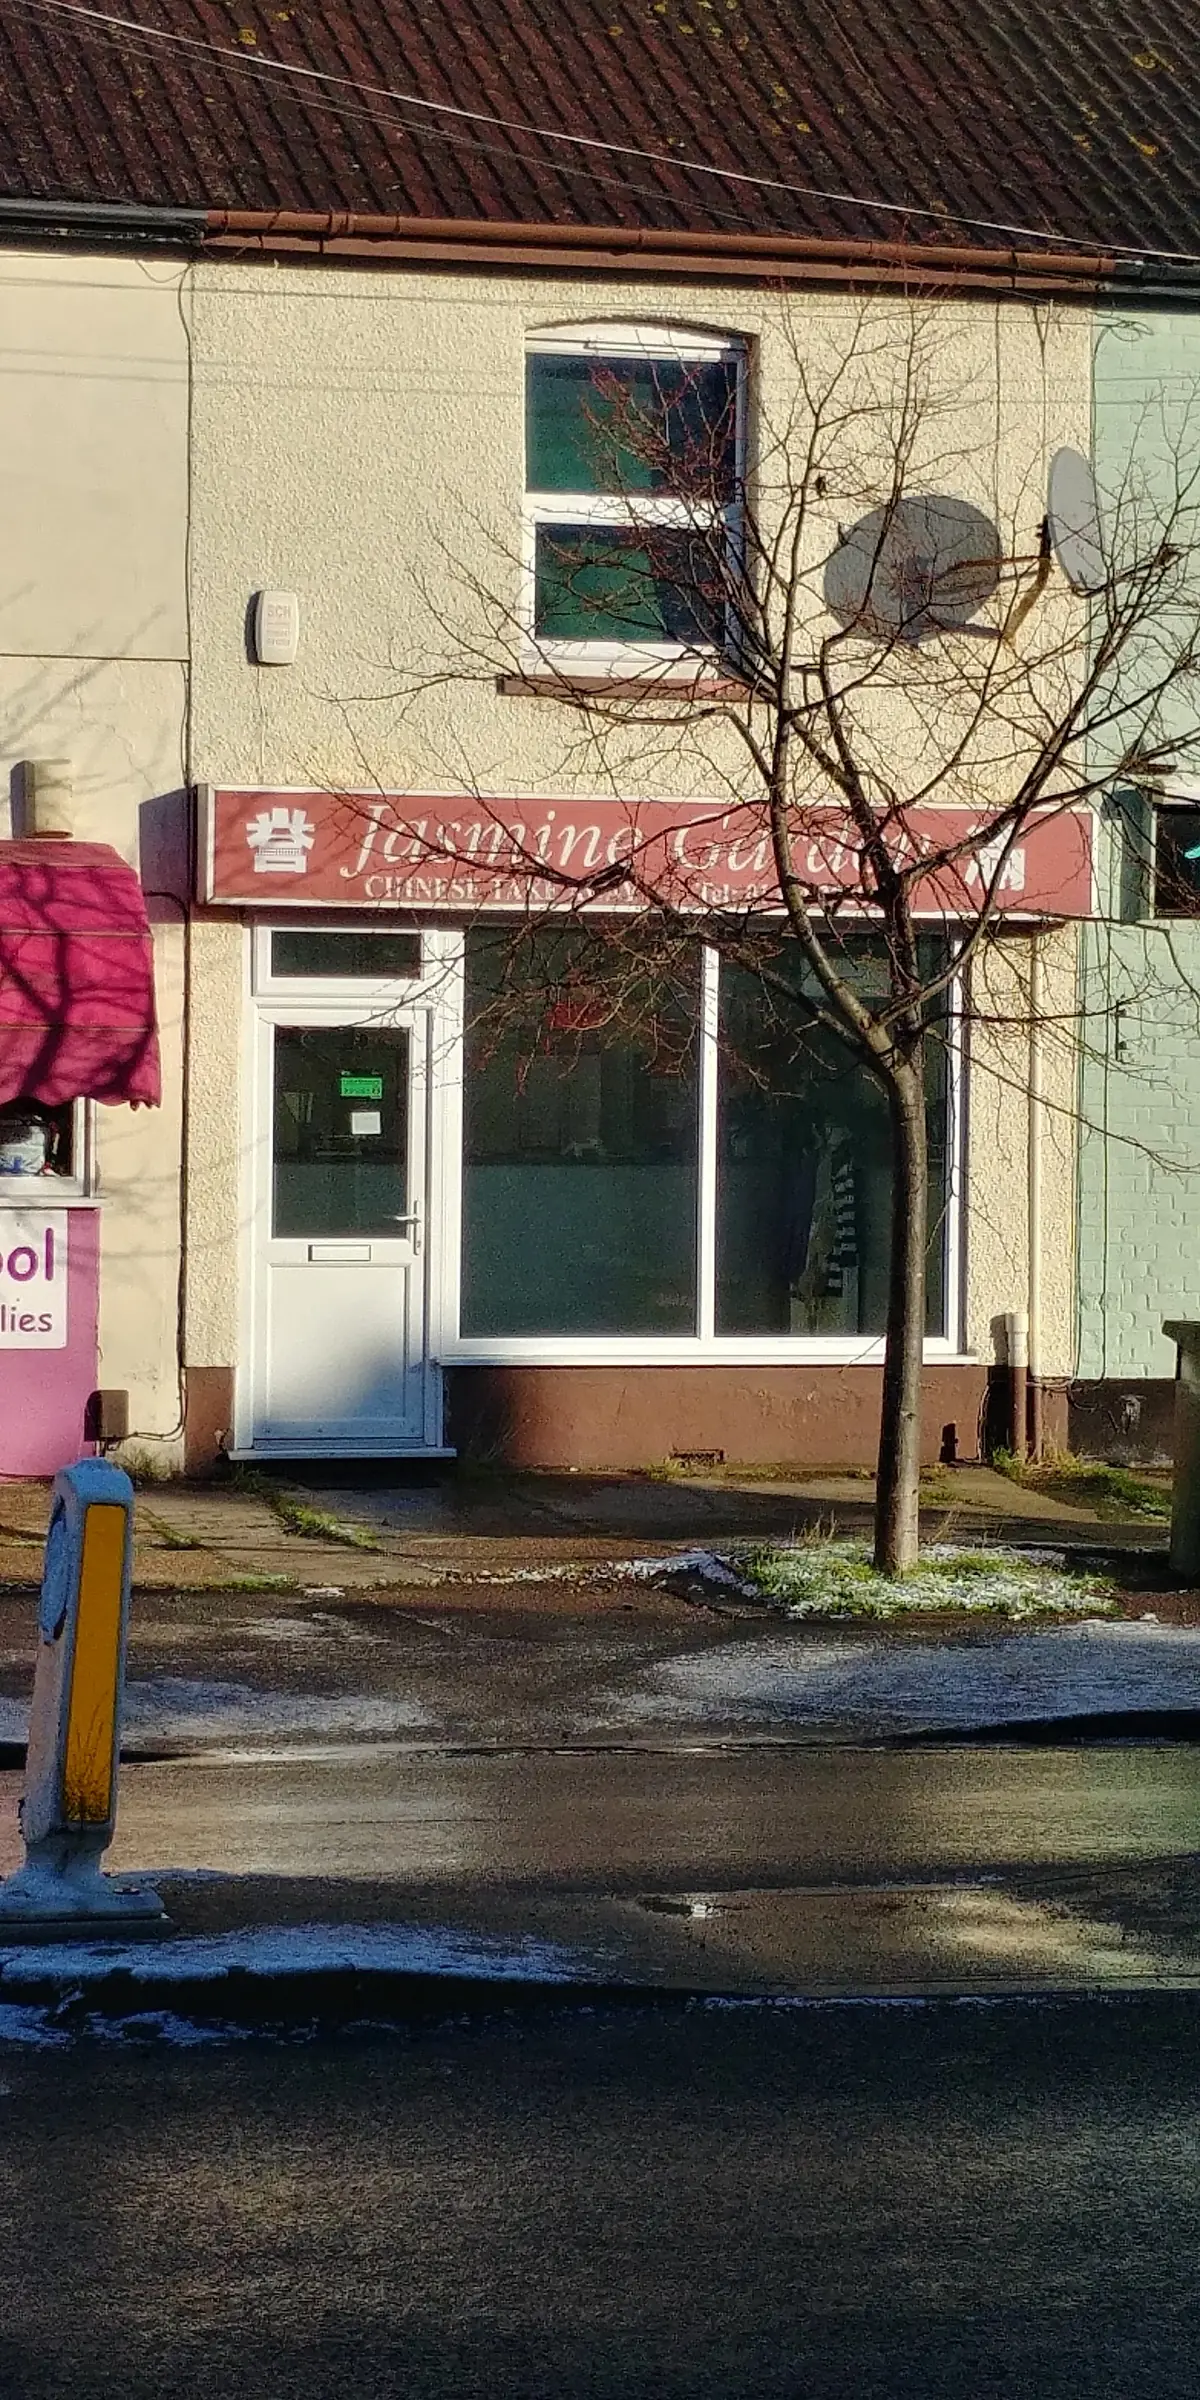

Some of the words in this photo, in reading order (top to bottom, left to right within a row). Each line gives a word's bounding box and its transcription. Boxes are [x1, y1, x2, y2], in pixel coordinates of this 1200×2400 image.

[339, 803, 648, 878] Jasmine
[674, 811, 936, 876] Gadn
[364, 875, 481, 901] CHINESE
[491, 877, 556, 901] TAKE
[0, 1227, 54, 1281] ol
[1, 1304, 52, 1332] lies
